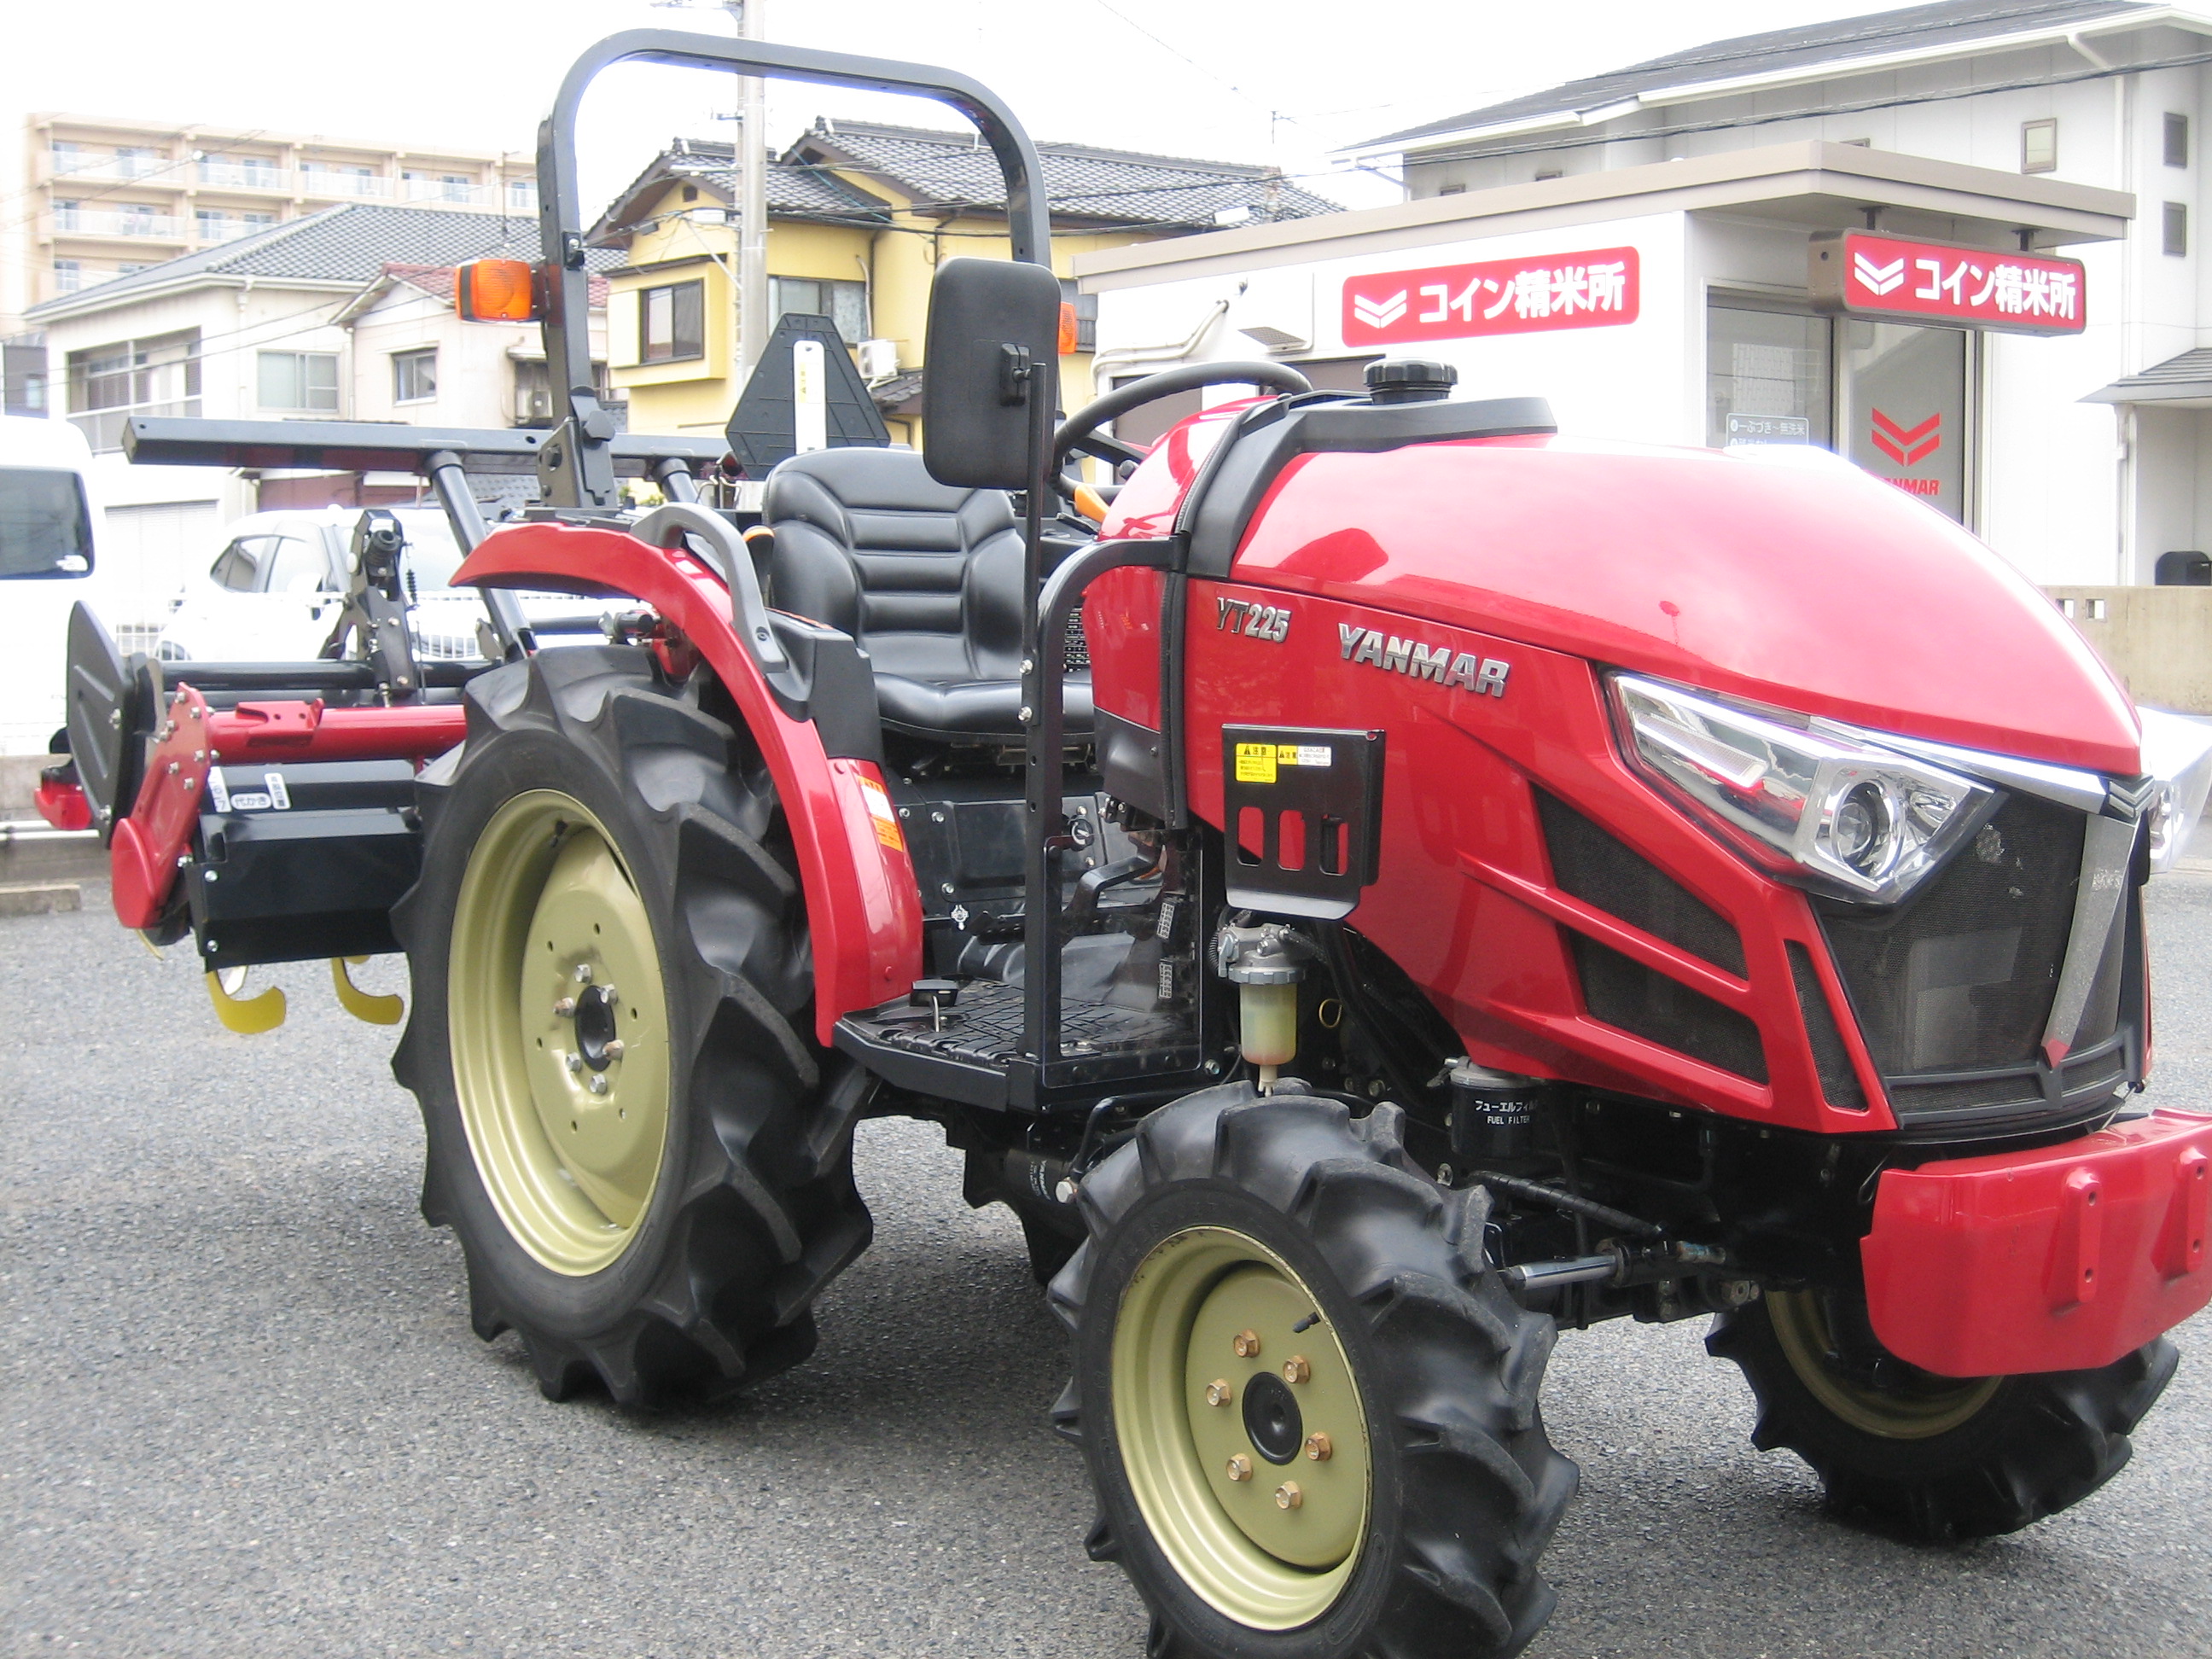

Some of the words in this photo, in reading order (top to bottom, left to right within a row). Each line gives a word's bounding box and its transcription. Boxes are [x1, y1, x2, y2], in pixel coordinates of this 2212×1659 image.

[1419, 261, 1626, 323] コイン精米所
[1914, 259, 2075, 320] コイン精米所
[1217, 597, 1293, 643] YT225
[1338, 622, 1511, 698] YANMAR
[1487, 1115, 1505, 1125] FUEL
[1508, 1115, 1531, 1125] FILTER
